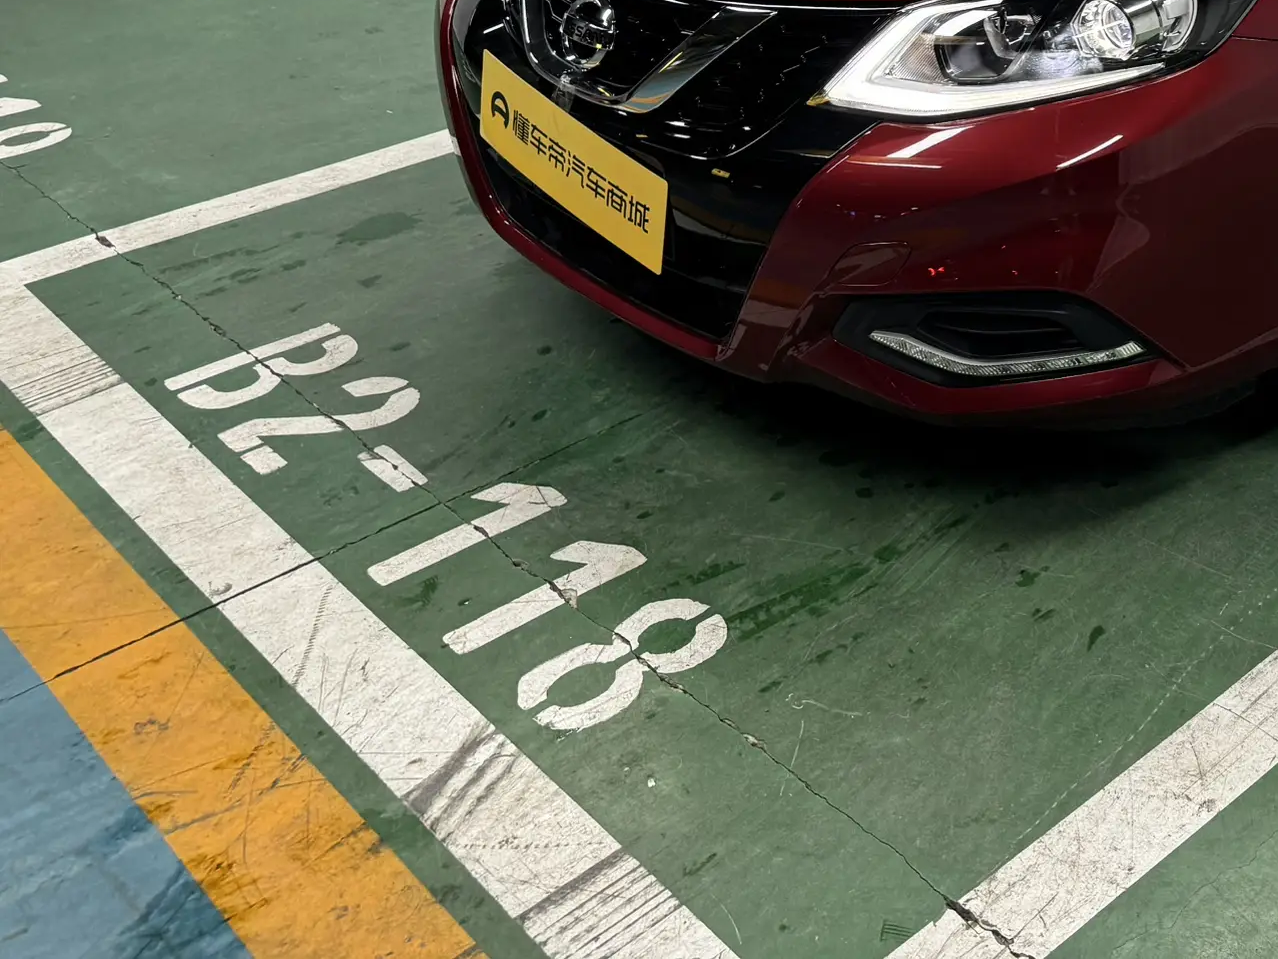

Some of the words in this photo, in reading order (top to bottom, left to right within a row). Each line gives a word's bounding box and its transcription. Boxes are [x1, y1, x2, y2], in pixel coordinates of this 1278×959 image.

[512, 108, 651, 234] 懂车帝汽车商城
[163, 322, 728, 732] B2-118
